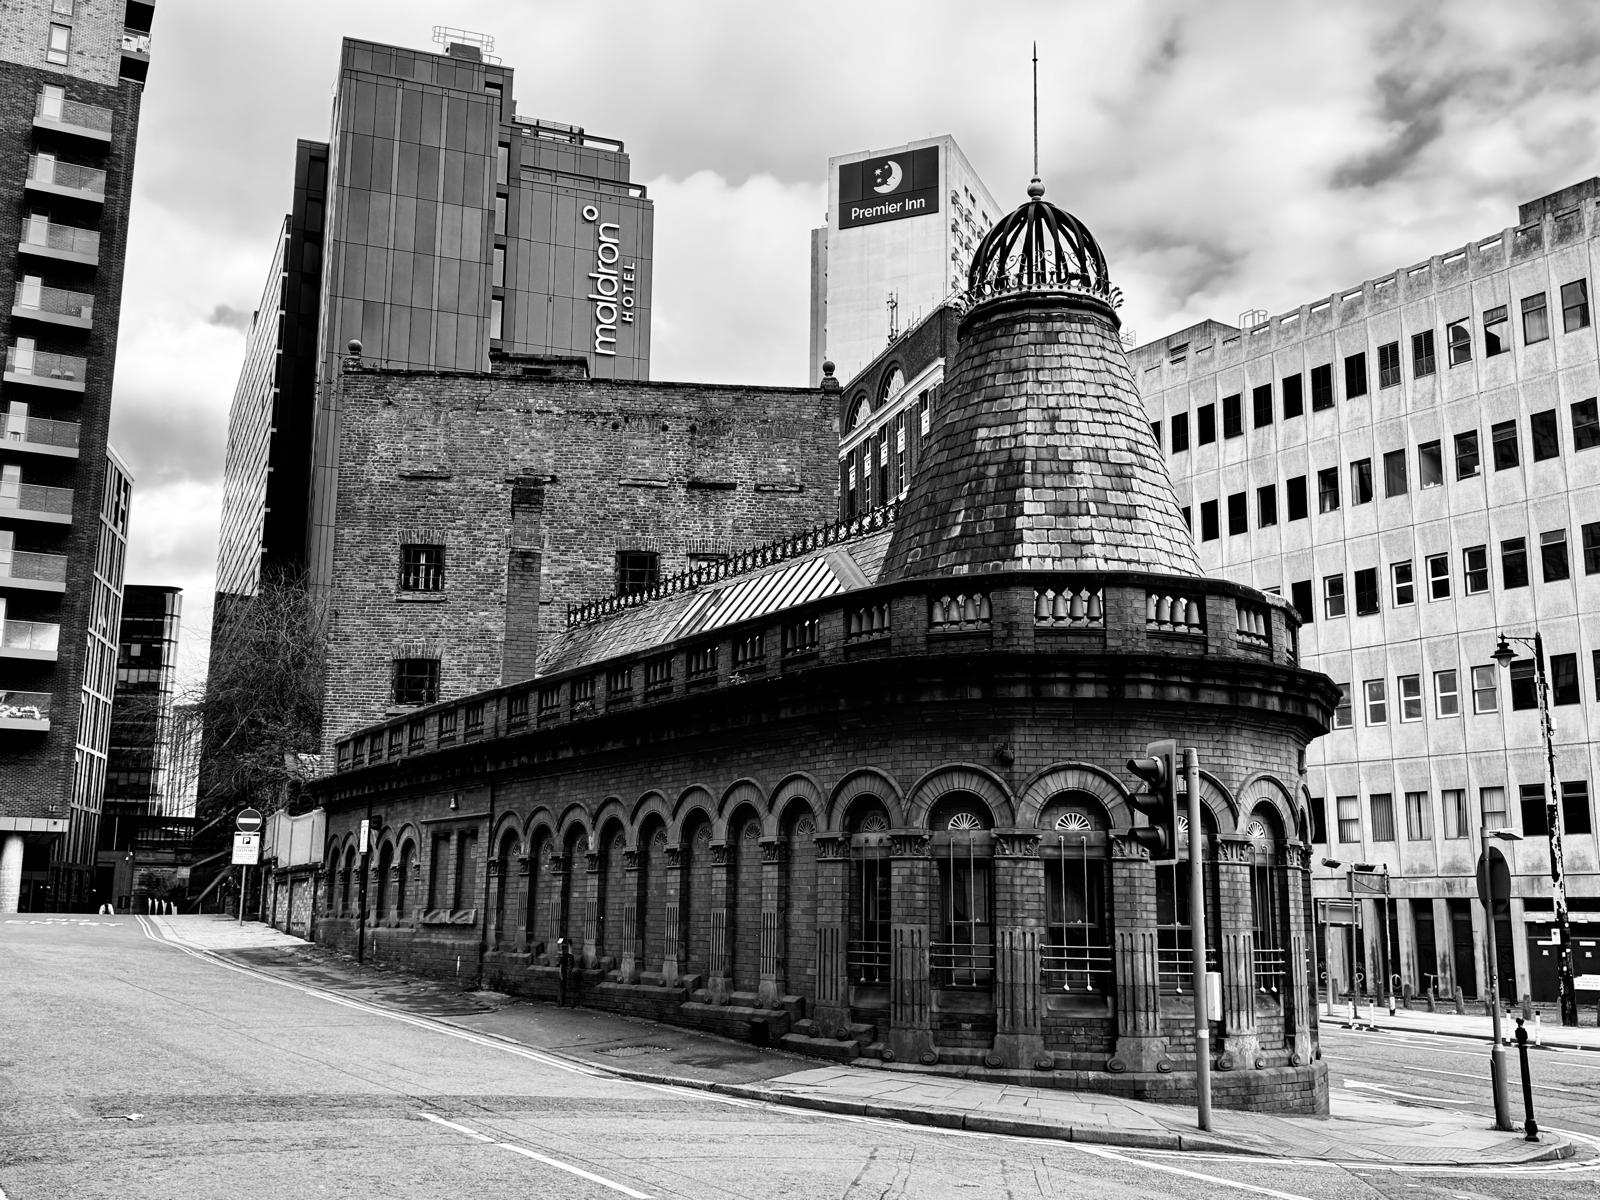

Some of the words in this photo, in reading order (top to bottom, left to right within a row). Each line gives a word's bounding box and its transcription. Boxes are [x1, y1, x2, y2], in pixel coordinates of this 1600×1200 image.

[851, 201, 903, 220] Premier
[905, 198, 926, 211] Inn
[588, 222, 620, 355] maldron
[622, 262, 635, 322] HOTEL
